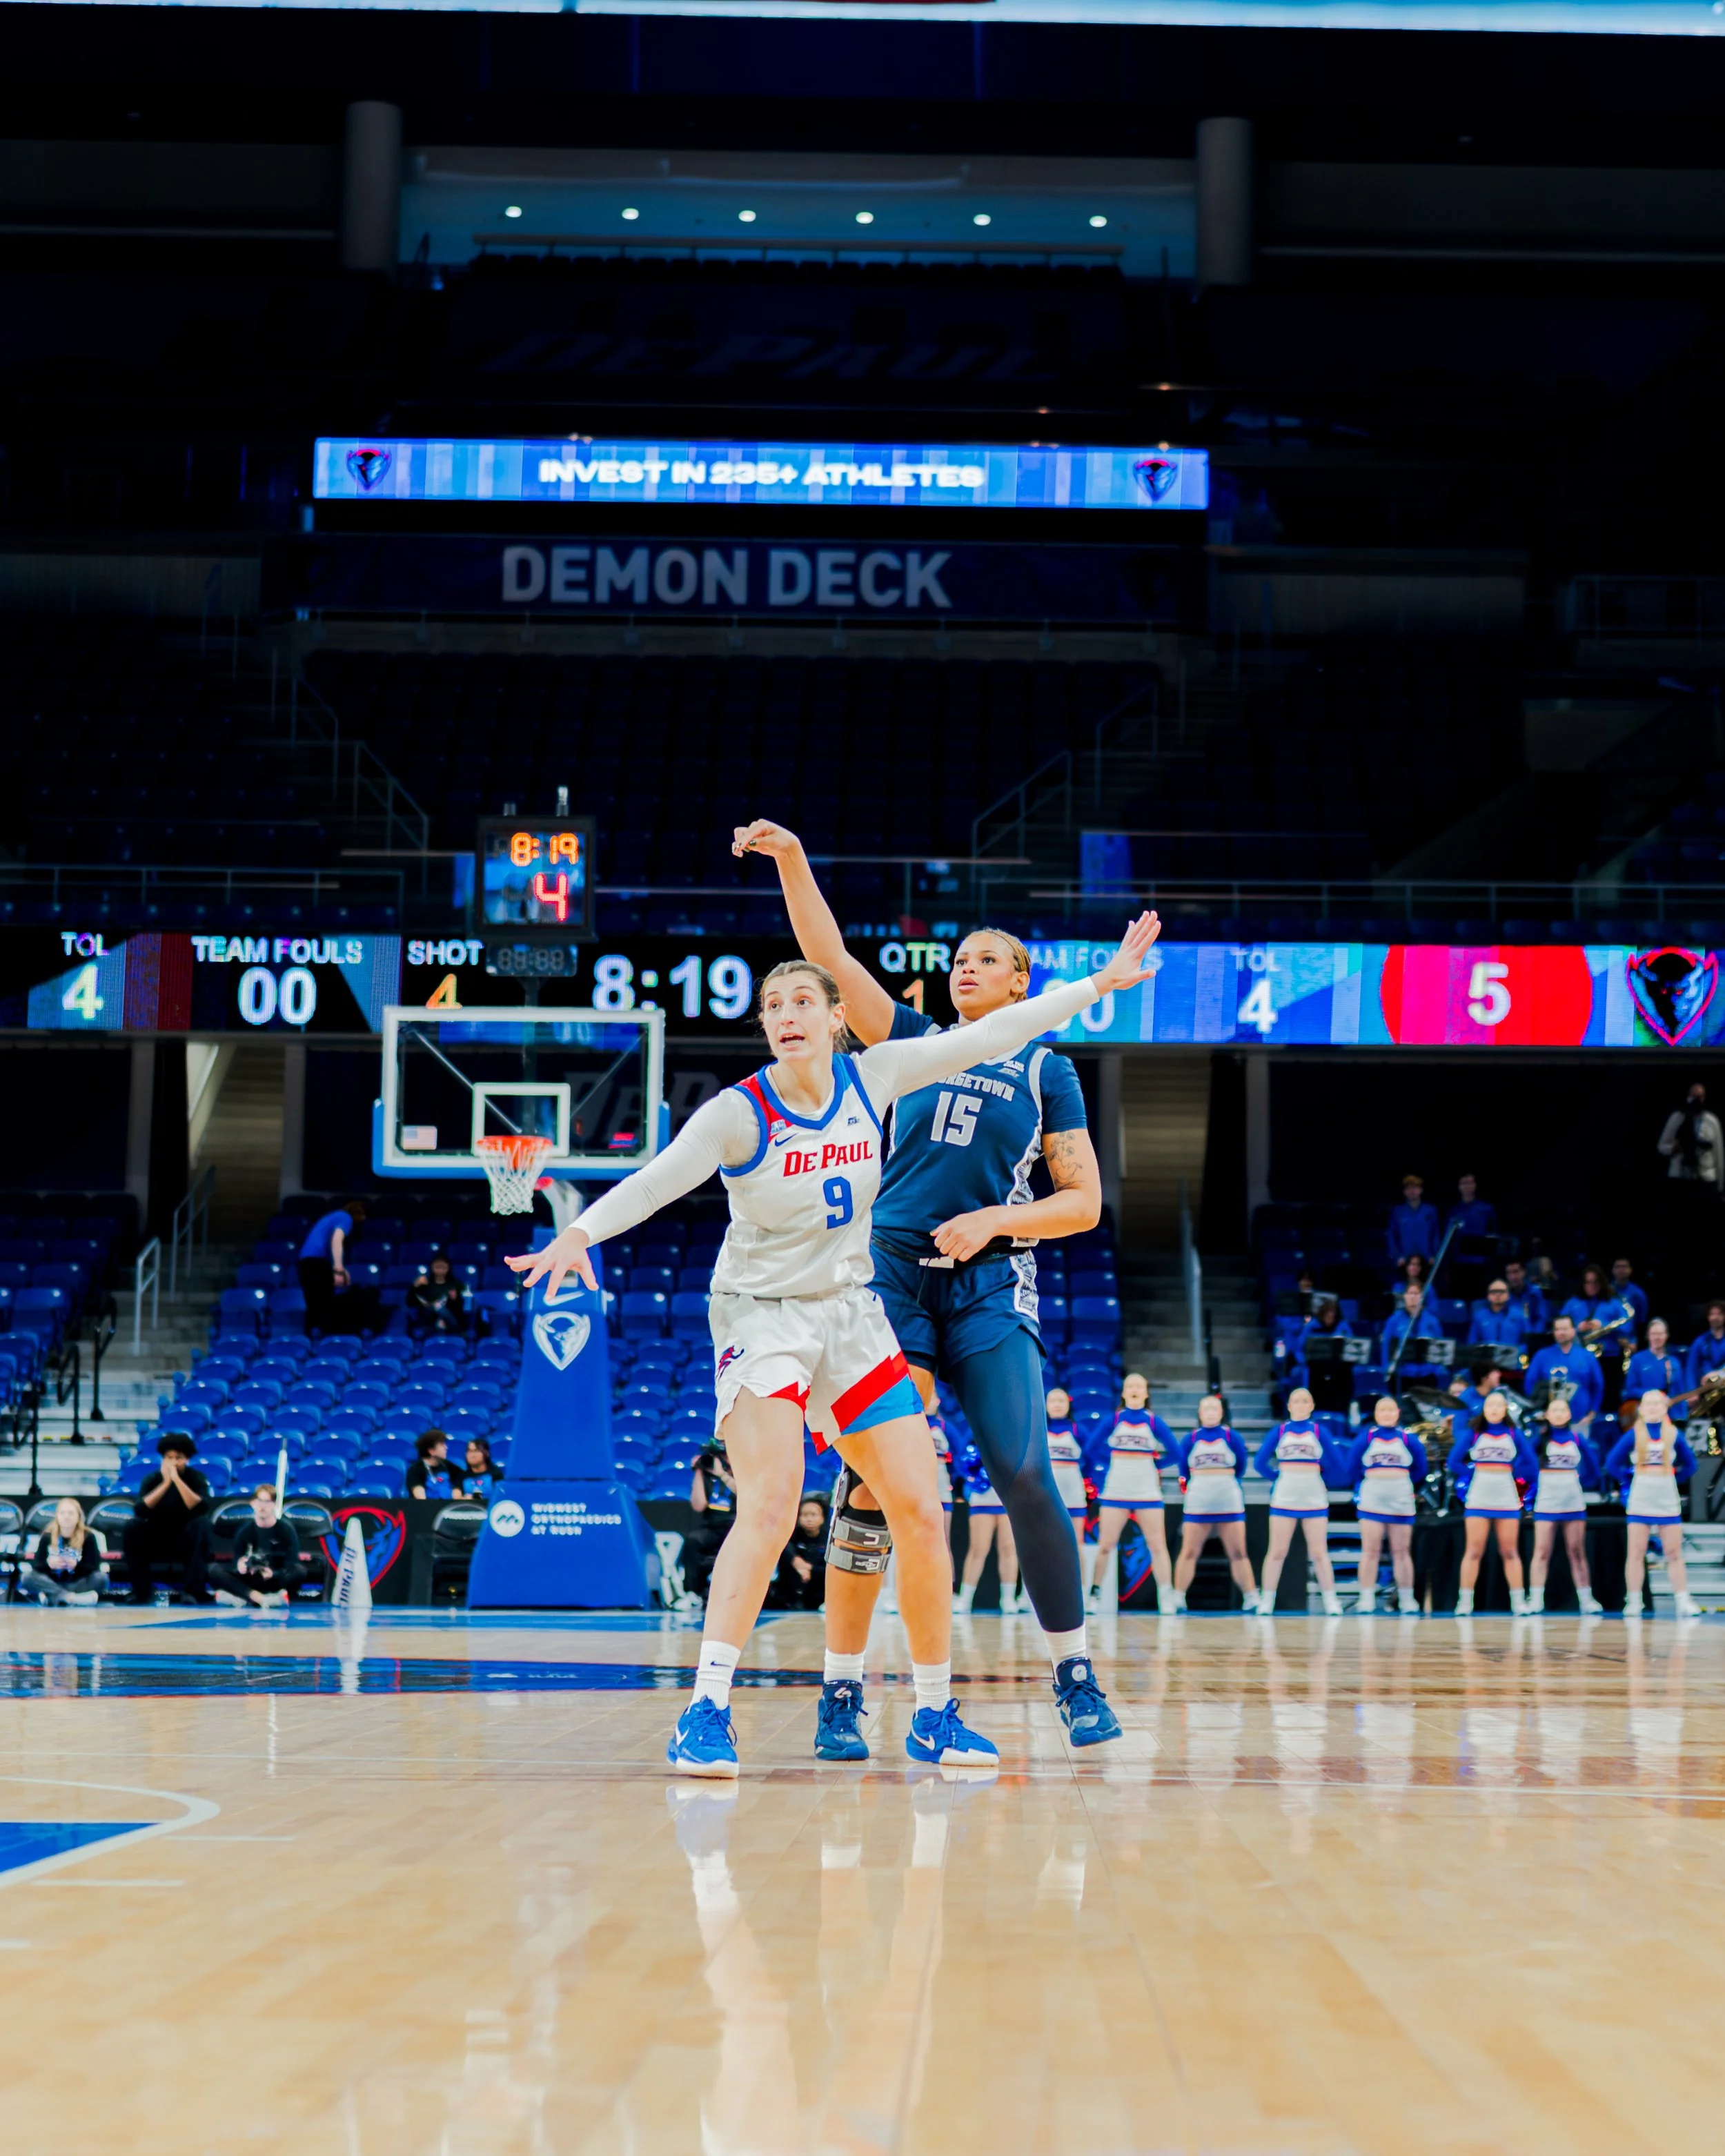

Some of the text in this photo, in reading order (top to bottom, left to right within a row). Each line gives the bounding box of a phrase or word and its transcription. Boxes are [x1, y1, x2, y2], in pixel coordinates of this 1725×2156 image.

[538, 459, 985, 487] INVEST IN 235+ ATHLETES
[502, 546, 953, 609] DEMON DECK
[511, 832, 579, 867] 8:19
[534, 872, 568, 921] 4
[61, 932, 110, 956] TOL
[191, 935, 364, 965] TEAM FOULS
[407, 939, 484, 965] SHOT
[879, 942, 951, 972] QTR
[1230, 949, 1281, 972] TOL
[62, 963, 104, 1020] 4
[237, 966, 317, 1026] 00
[425, 973, 463, 1009] 4
[592, 955, 753, 1019] 8:19
[903, 978, 925, 1014] 1
[1467, 961, 1512, 1026] 5
[1237, 978, 1279, 1034] 4
[930, 1091, 983, 1147] 15
[822, 1176, 854, 1229] 9
[531, 1503, 586, 1513] MIDWEST
